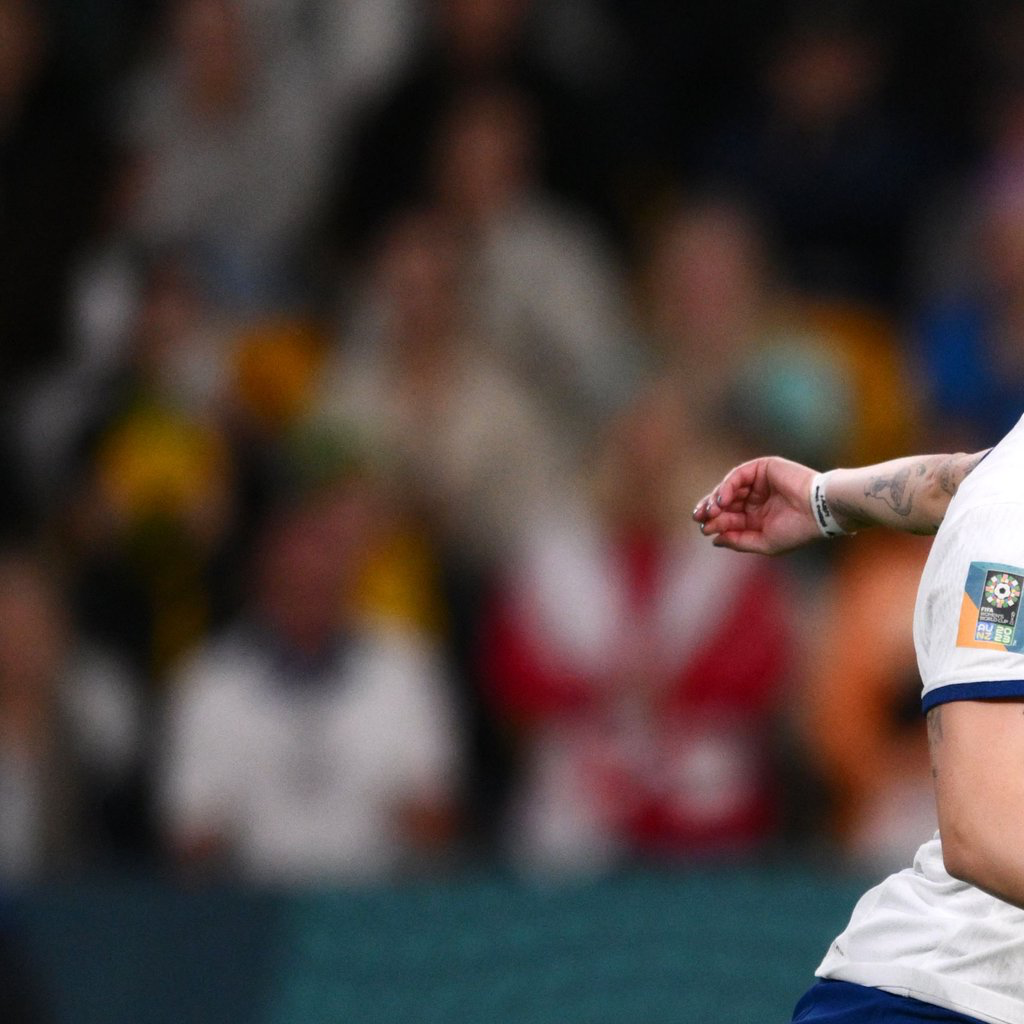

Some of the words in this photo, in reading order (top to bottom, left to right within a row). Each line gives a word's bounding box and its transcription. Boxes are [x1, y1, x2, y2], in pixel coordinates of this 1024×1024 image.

[978, 623, 993, 632] AU
[996, 626, 1012, 635] 20
[976, 631, 992, 640] NZ
[994, 634, 1010, 644] 23
